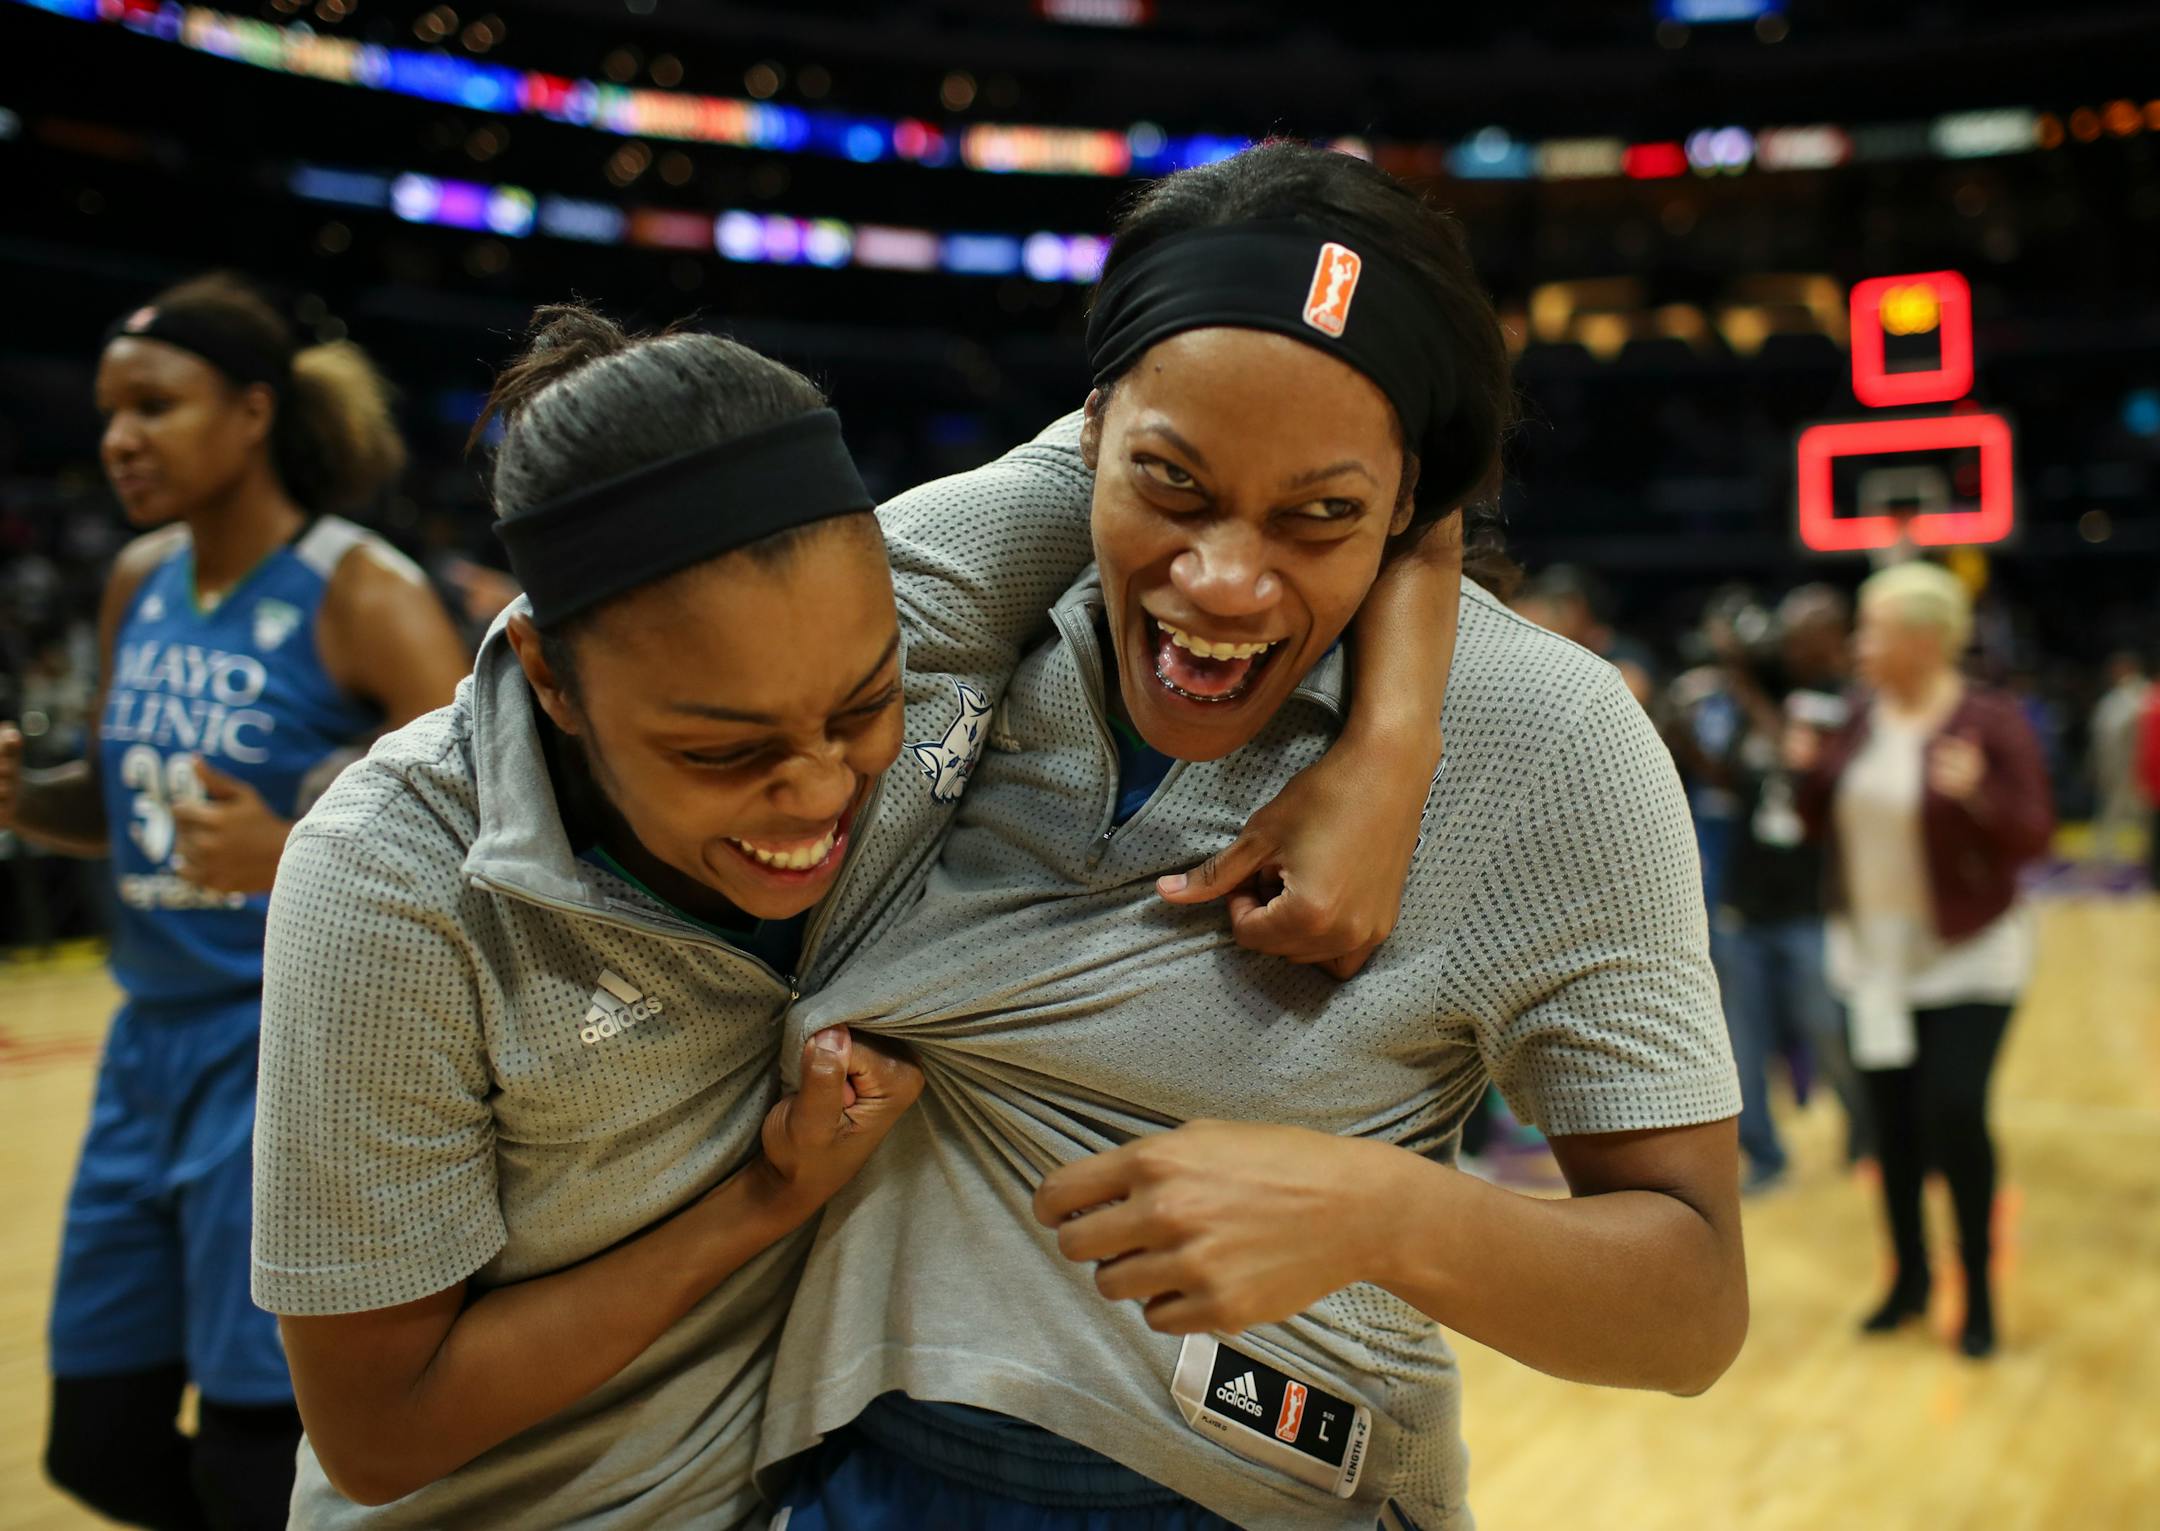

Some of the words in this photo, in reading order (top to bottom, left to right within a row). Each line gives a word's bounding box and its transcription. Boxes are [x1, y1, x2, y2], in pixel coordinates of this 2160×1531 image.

[115, 640, 267, 707] MAYO
[580, 996, 663, 1044] adidas
[1216, 1386, 1263, 1417] adidas
[1319, 1420, 1329, 1442] L
[1345, 1440, 1363, 1484] LENGTH
